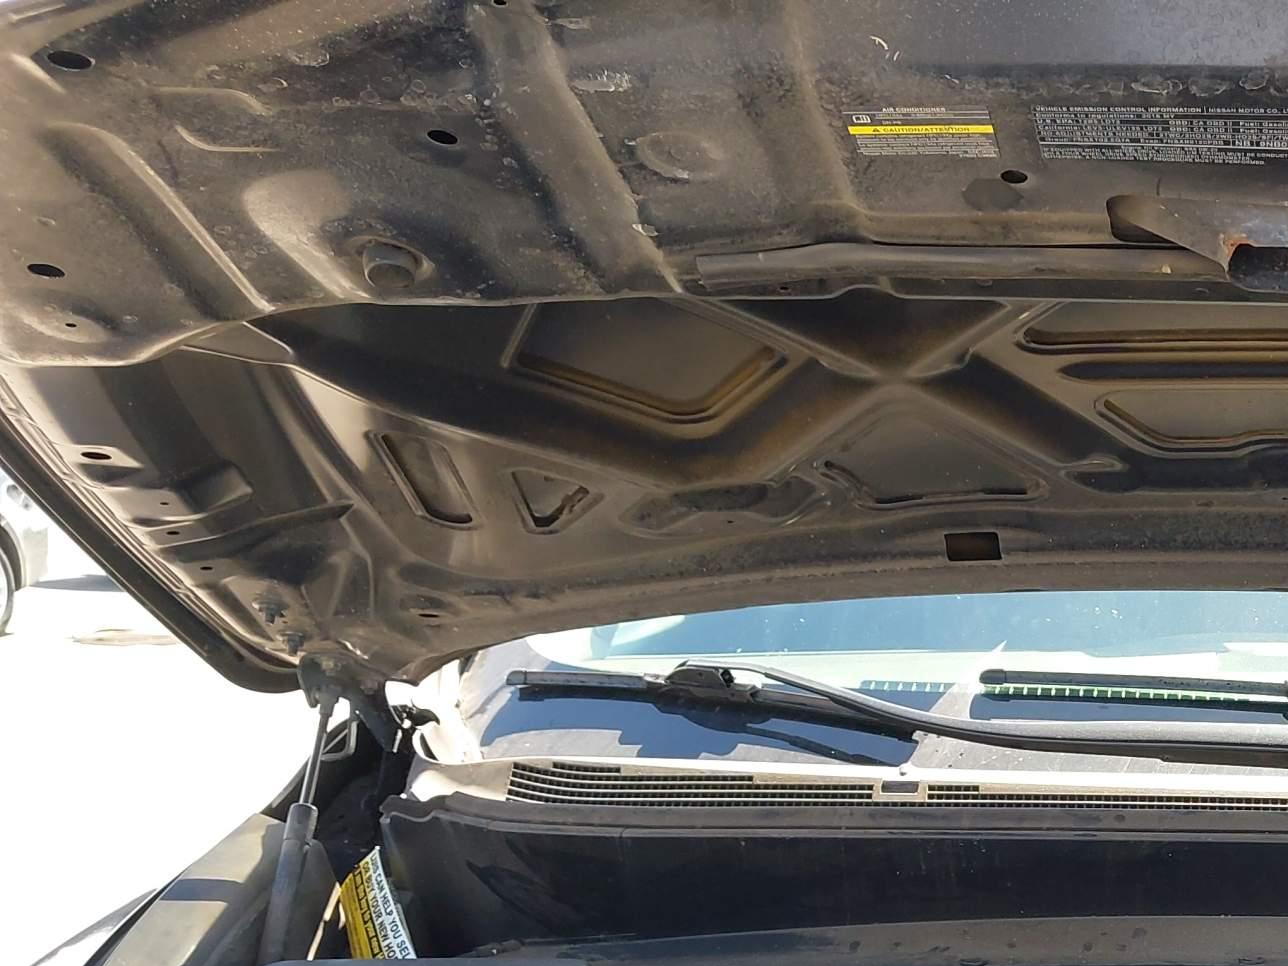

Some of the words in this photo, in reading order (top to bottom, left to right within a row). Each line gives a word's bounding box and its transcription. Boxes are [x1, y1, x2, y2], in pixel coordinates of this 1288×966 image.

[374, 872, 387, 894] CAN
[370, 893, 384, 919] YOUR
[380, 892, 394, 917] HELP
[376, 920, 390, 943] NEW
[389, 916, 402, 940] YOU
